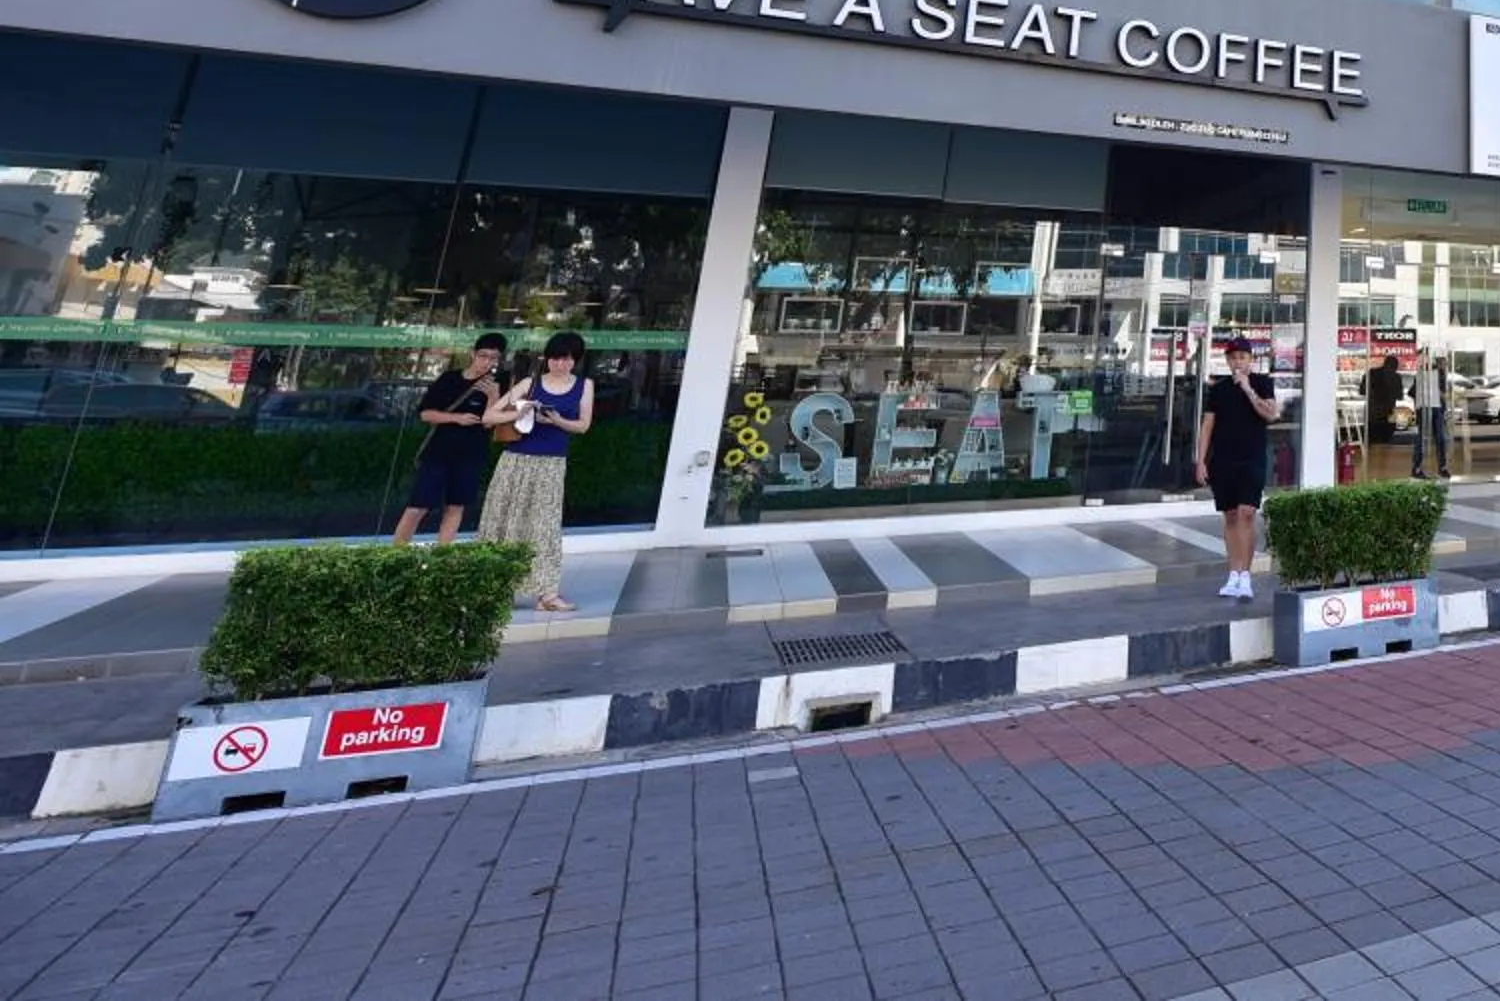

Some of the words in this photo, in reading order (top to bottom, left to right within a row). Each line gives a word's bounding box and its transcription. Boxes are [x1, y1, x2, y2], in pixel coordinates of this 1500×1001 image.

[1116, 18, 1365, 97] COFFEE
[778, 390, 1080, 487] SEAT
[1379, 588, 1396, 599] No
[1368, 599, 1408, 615] parking
[372, 707, 403, 726] No
[339, 726, 426, 750] parking
